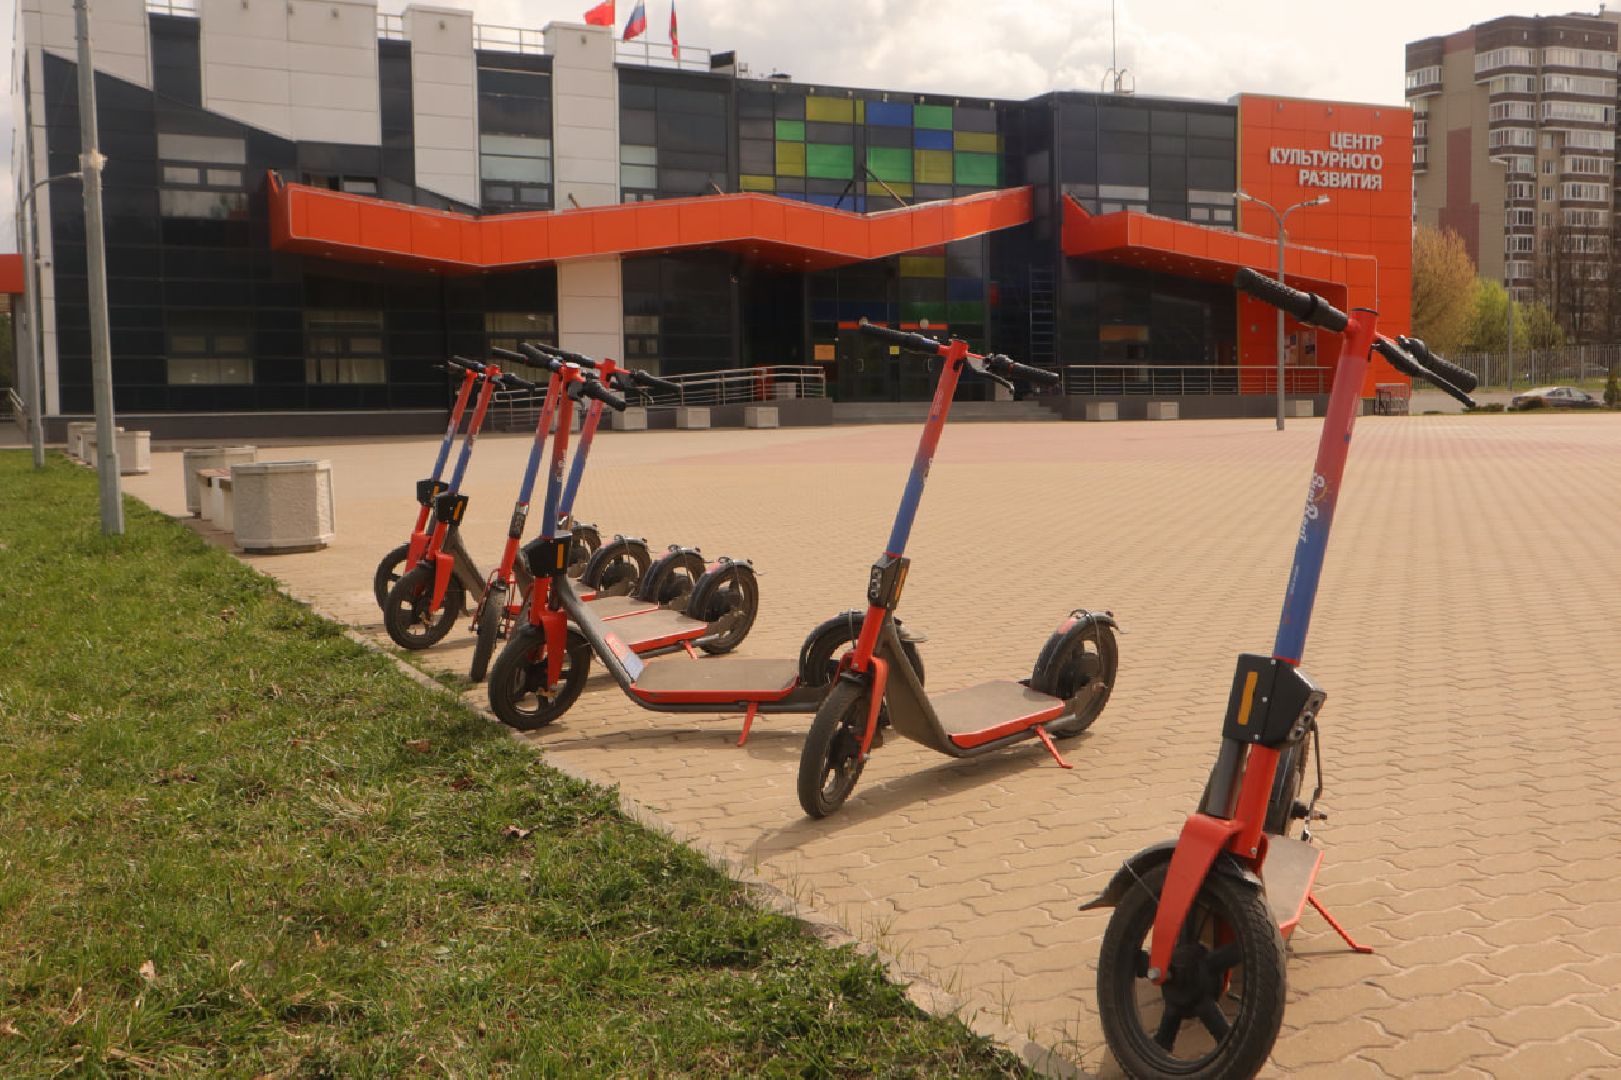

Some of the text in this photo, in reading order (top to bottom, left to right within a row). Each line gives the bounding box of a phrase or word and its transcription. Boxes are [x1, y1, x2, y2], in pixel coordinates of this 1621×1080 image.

[1330, 131, 1382, 150] ЦЕНТР
[1269, 147, 1382, 170] КУЛЬТУРНОГО
[1299, 169, 1382, 190] РАЗВИТИЯ
